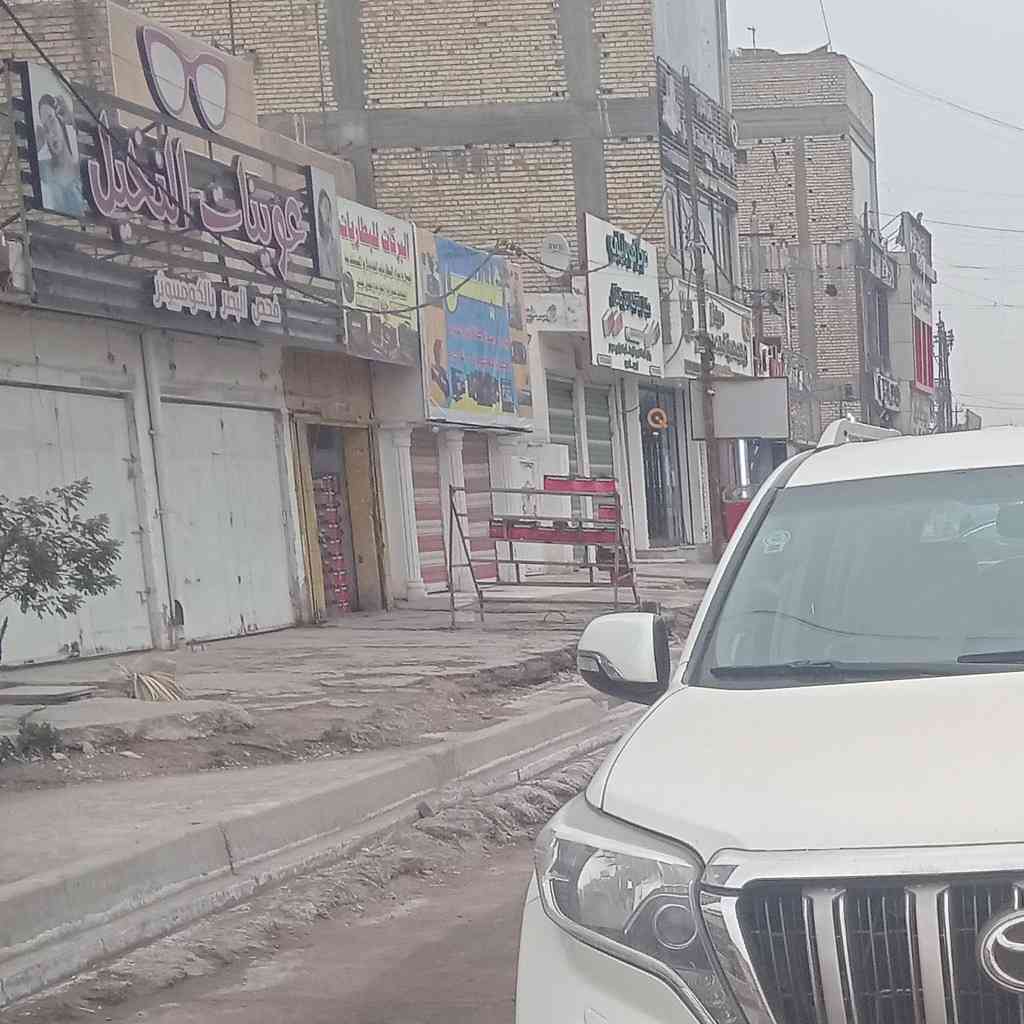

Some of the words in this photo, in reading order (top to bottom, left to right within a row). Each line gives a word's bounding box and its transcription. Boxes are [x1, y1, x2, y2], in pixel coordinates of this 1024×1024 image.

[88, 110, 191, 244] النخيل
[201, 155, 309, 281] عوينات
[220, 286, 248, 323] البصر
[251, 287, 281, 327] فحص
